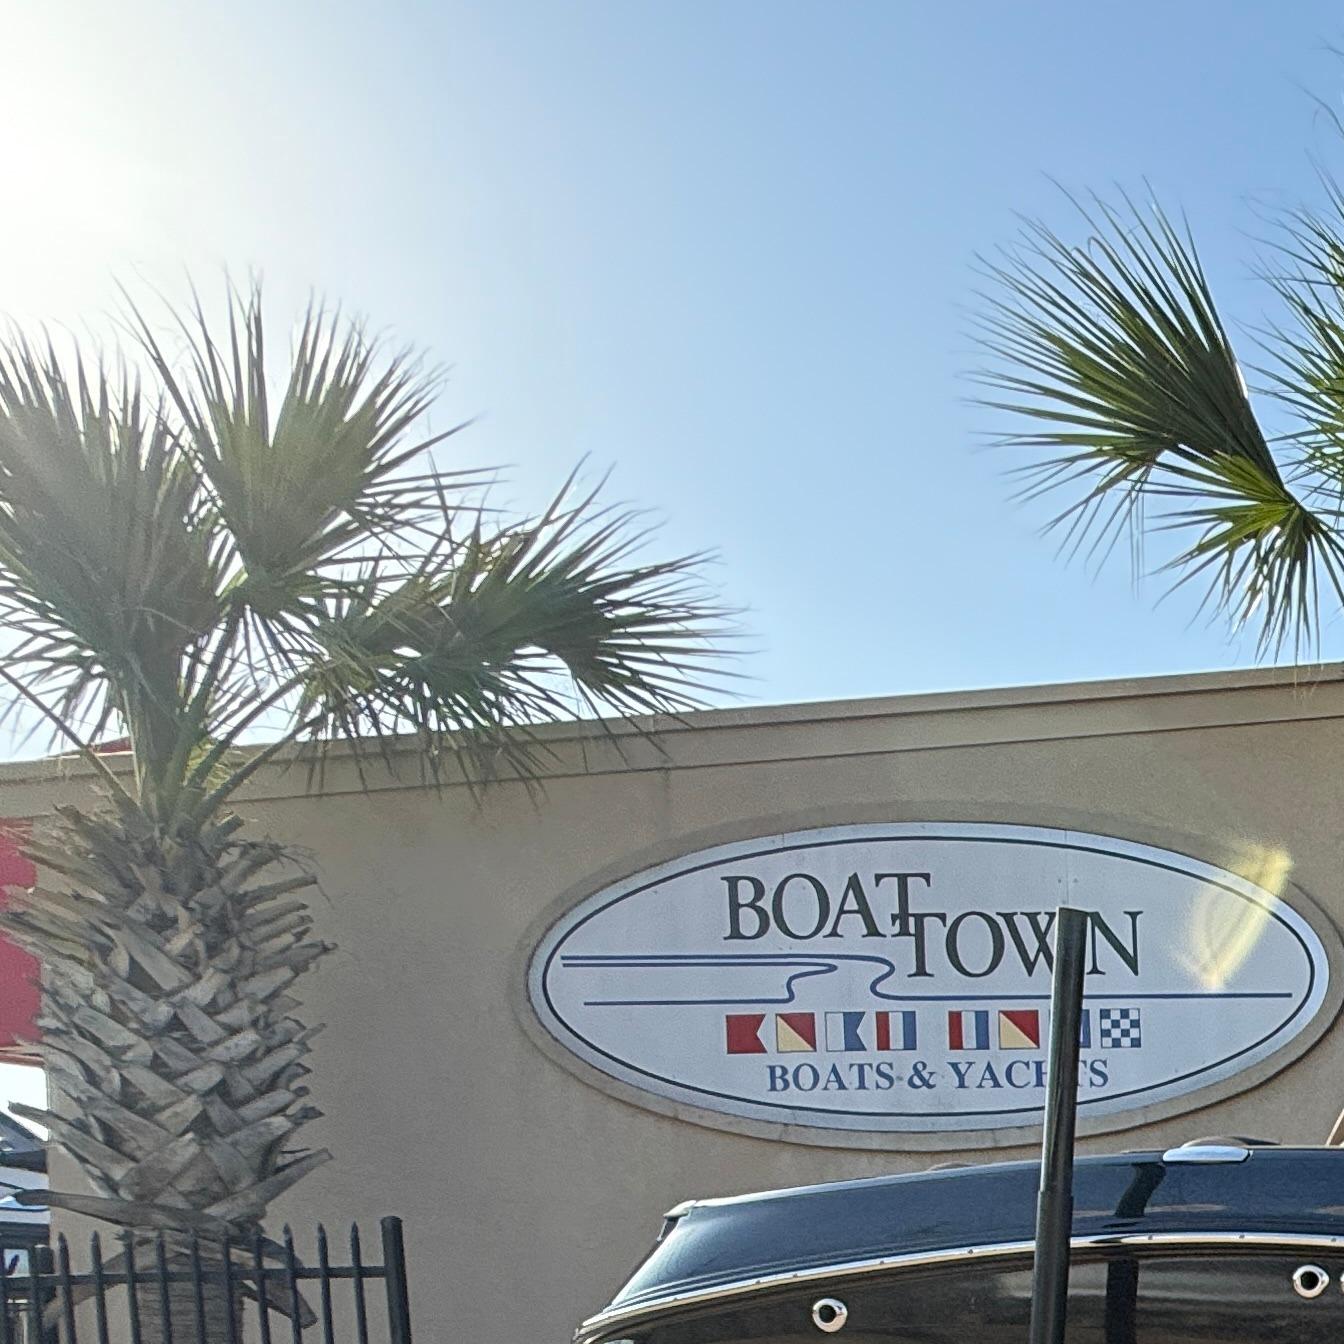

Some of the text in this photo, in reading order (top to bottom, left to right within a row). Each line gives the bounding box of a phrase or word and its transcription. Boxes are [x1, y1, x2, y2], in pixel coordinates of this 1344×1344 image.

[720, 872, 931, 940] BOAT
[766, 1061, 895, 1092] BOATS
[907, 1060, 937, 1090] &
